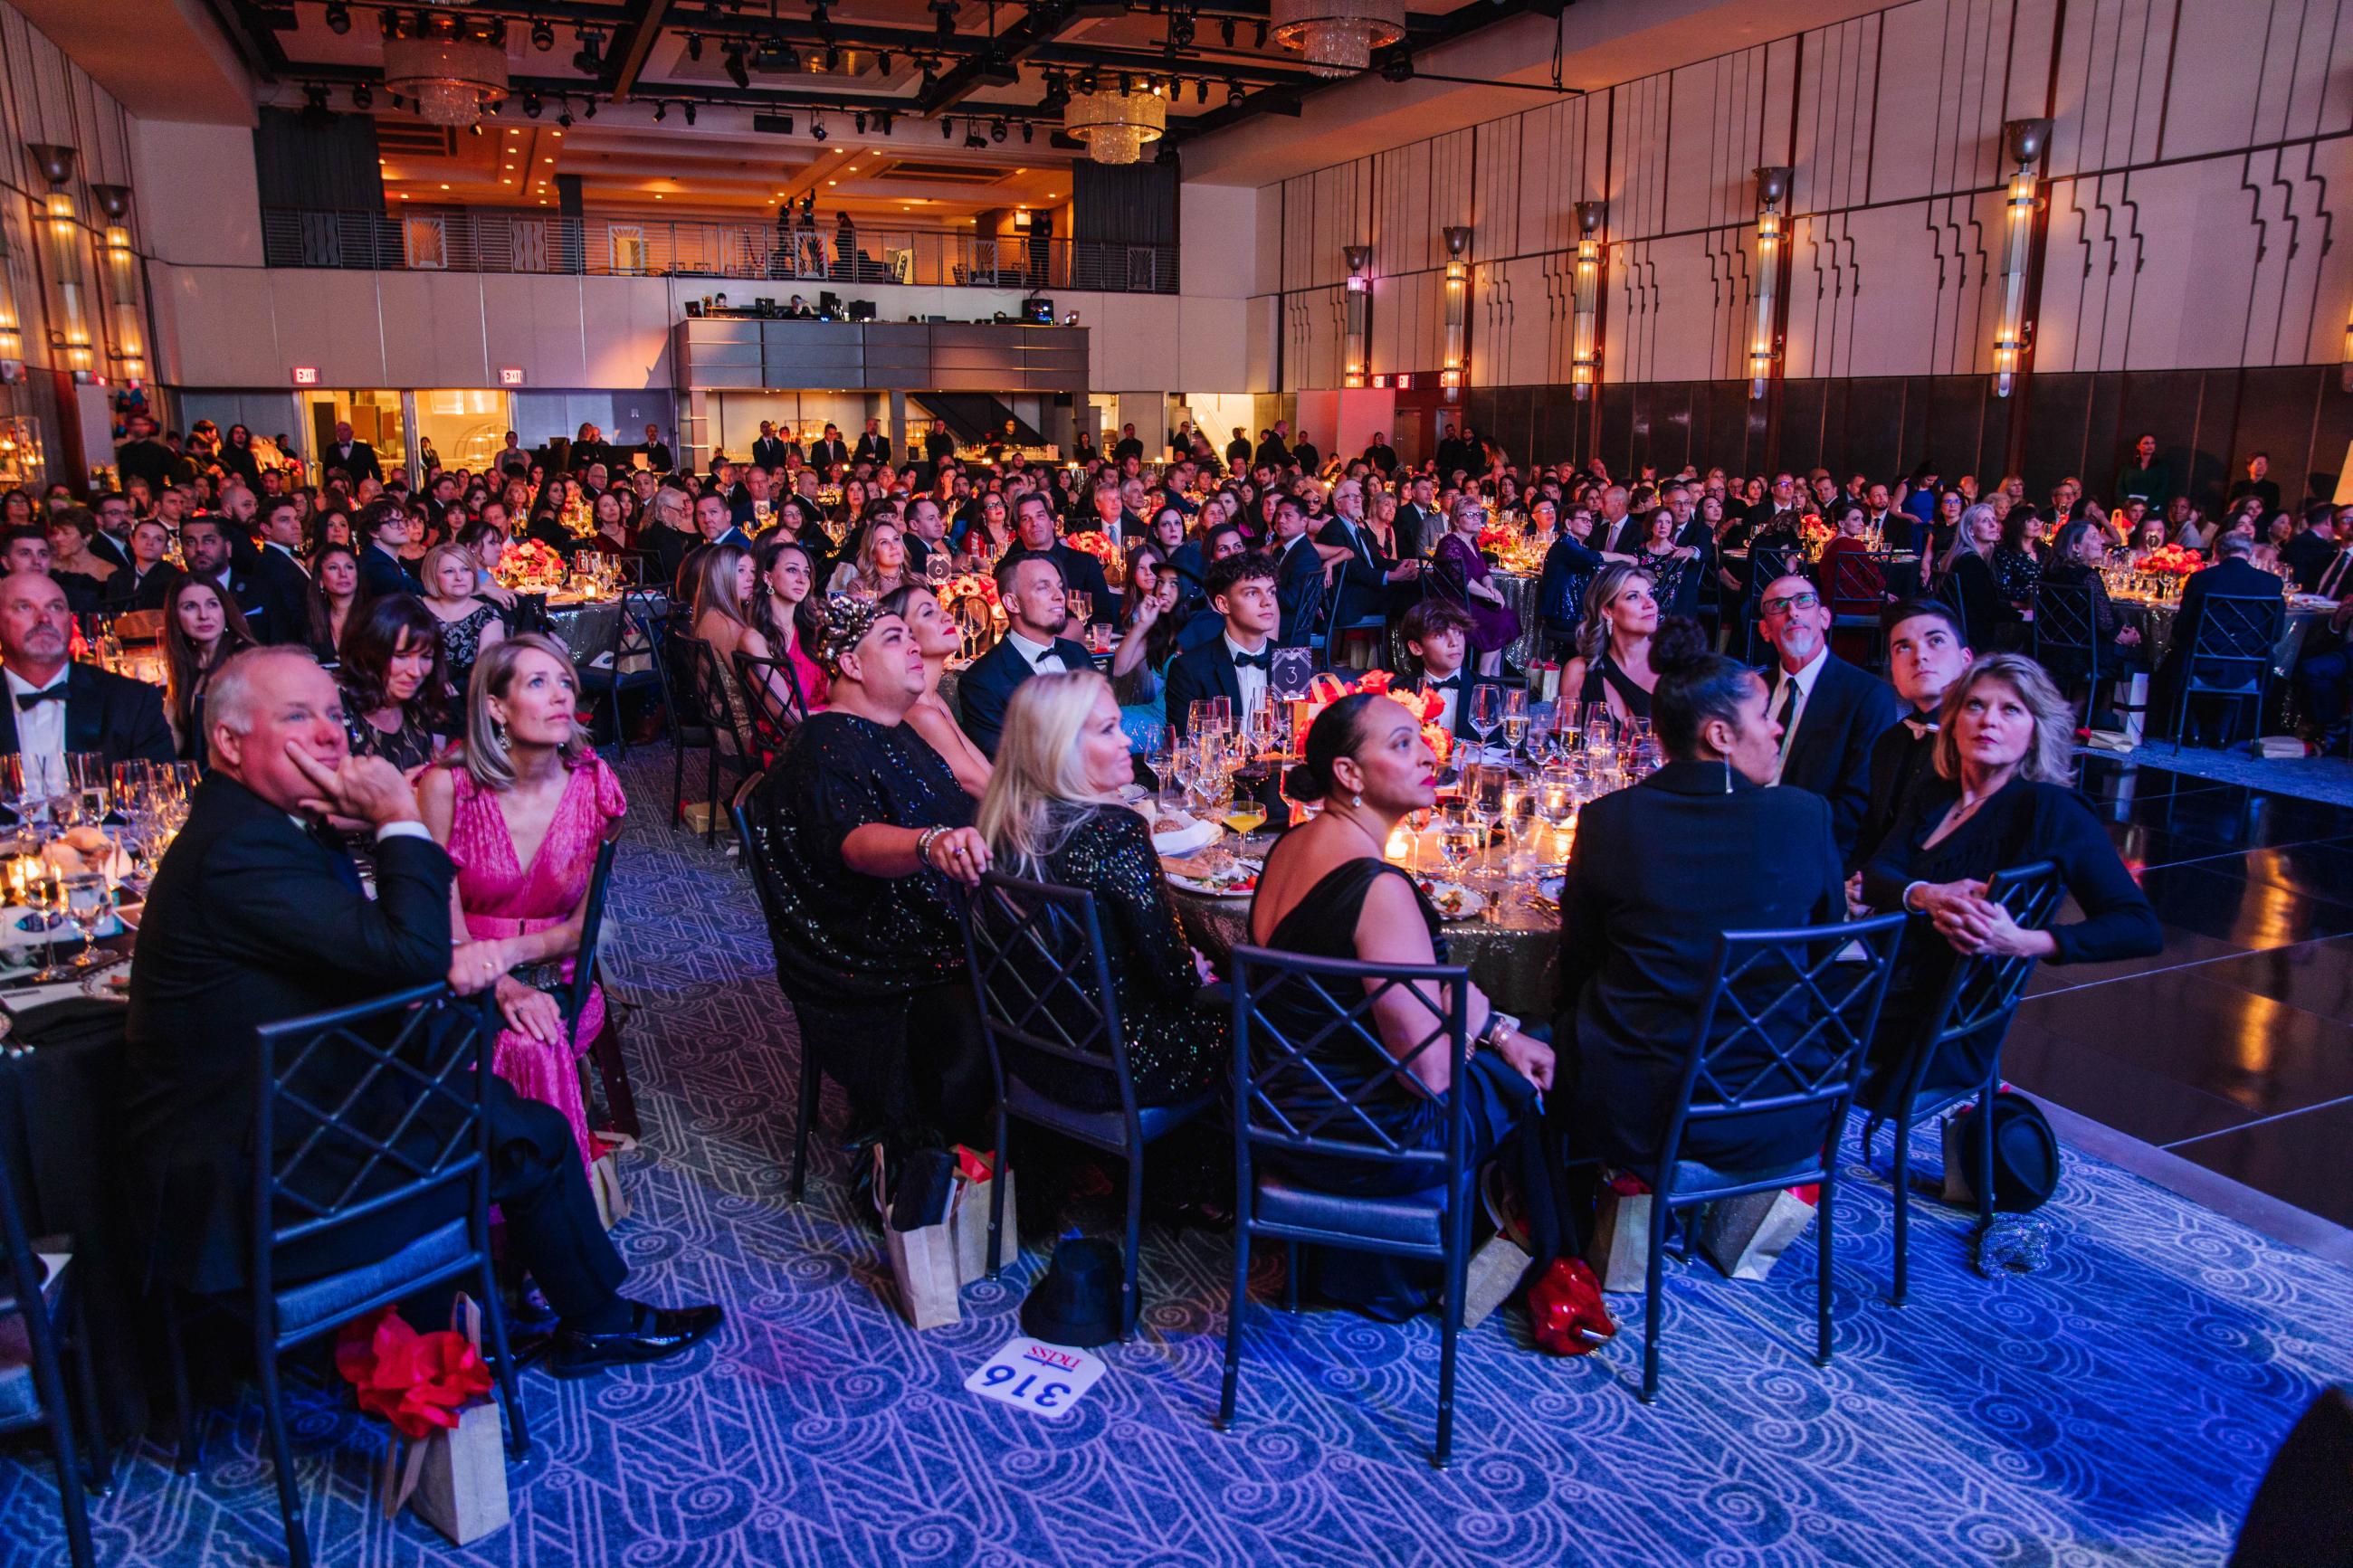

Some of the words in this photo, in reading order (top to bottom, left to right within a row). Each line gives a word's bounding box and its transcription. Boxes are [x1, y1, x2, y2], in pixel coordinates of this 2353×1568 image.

[296, 368, 316, 383] EXIT
[503, 369, 522, 384] EXIT
[935, 564, 943, 575] 6
[1285, 666, 1298, 684] 3
[981, 1364, 1072, 1407] 316
